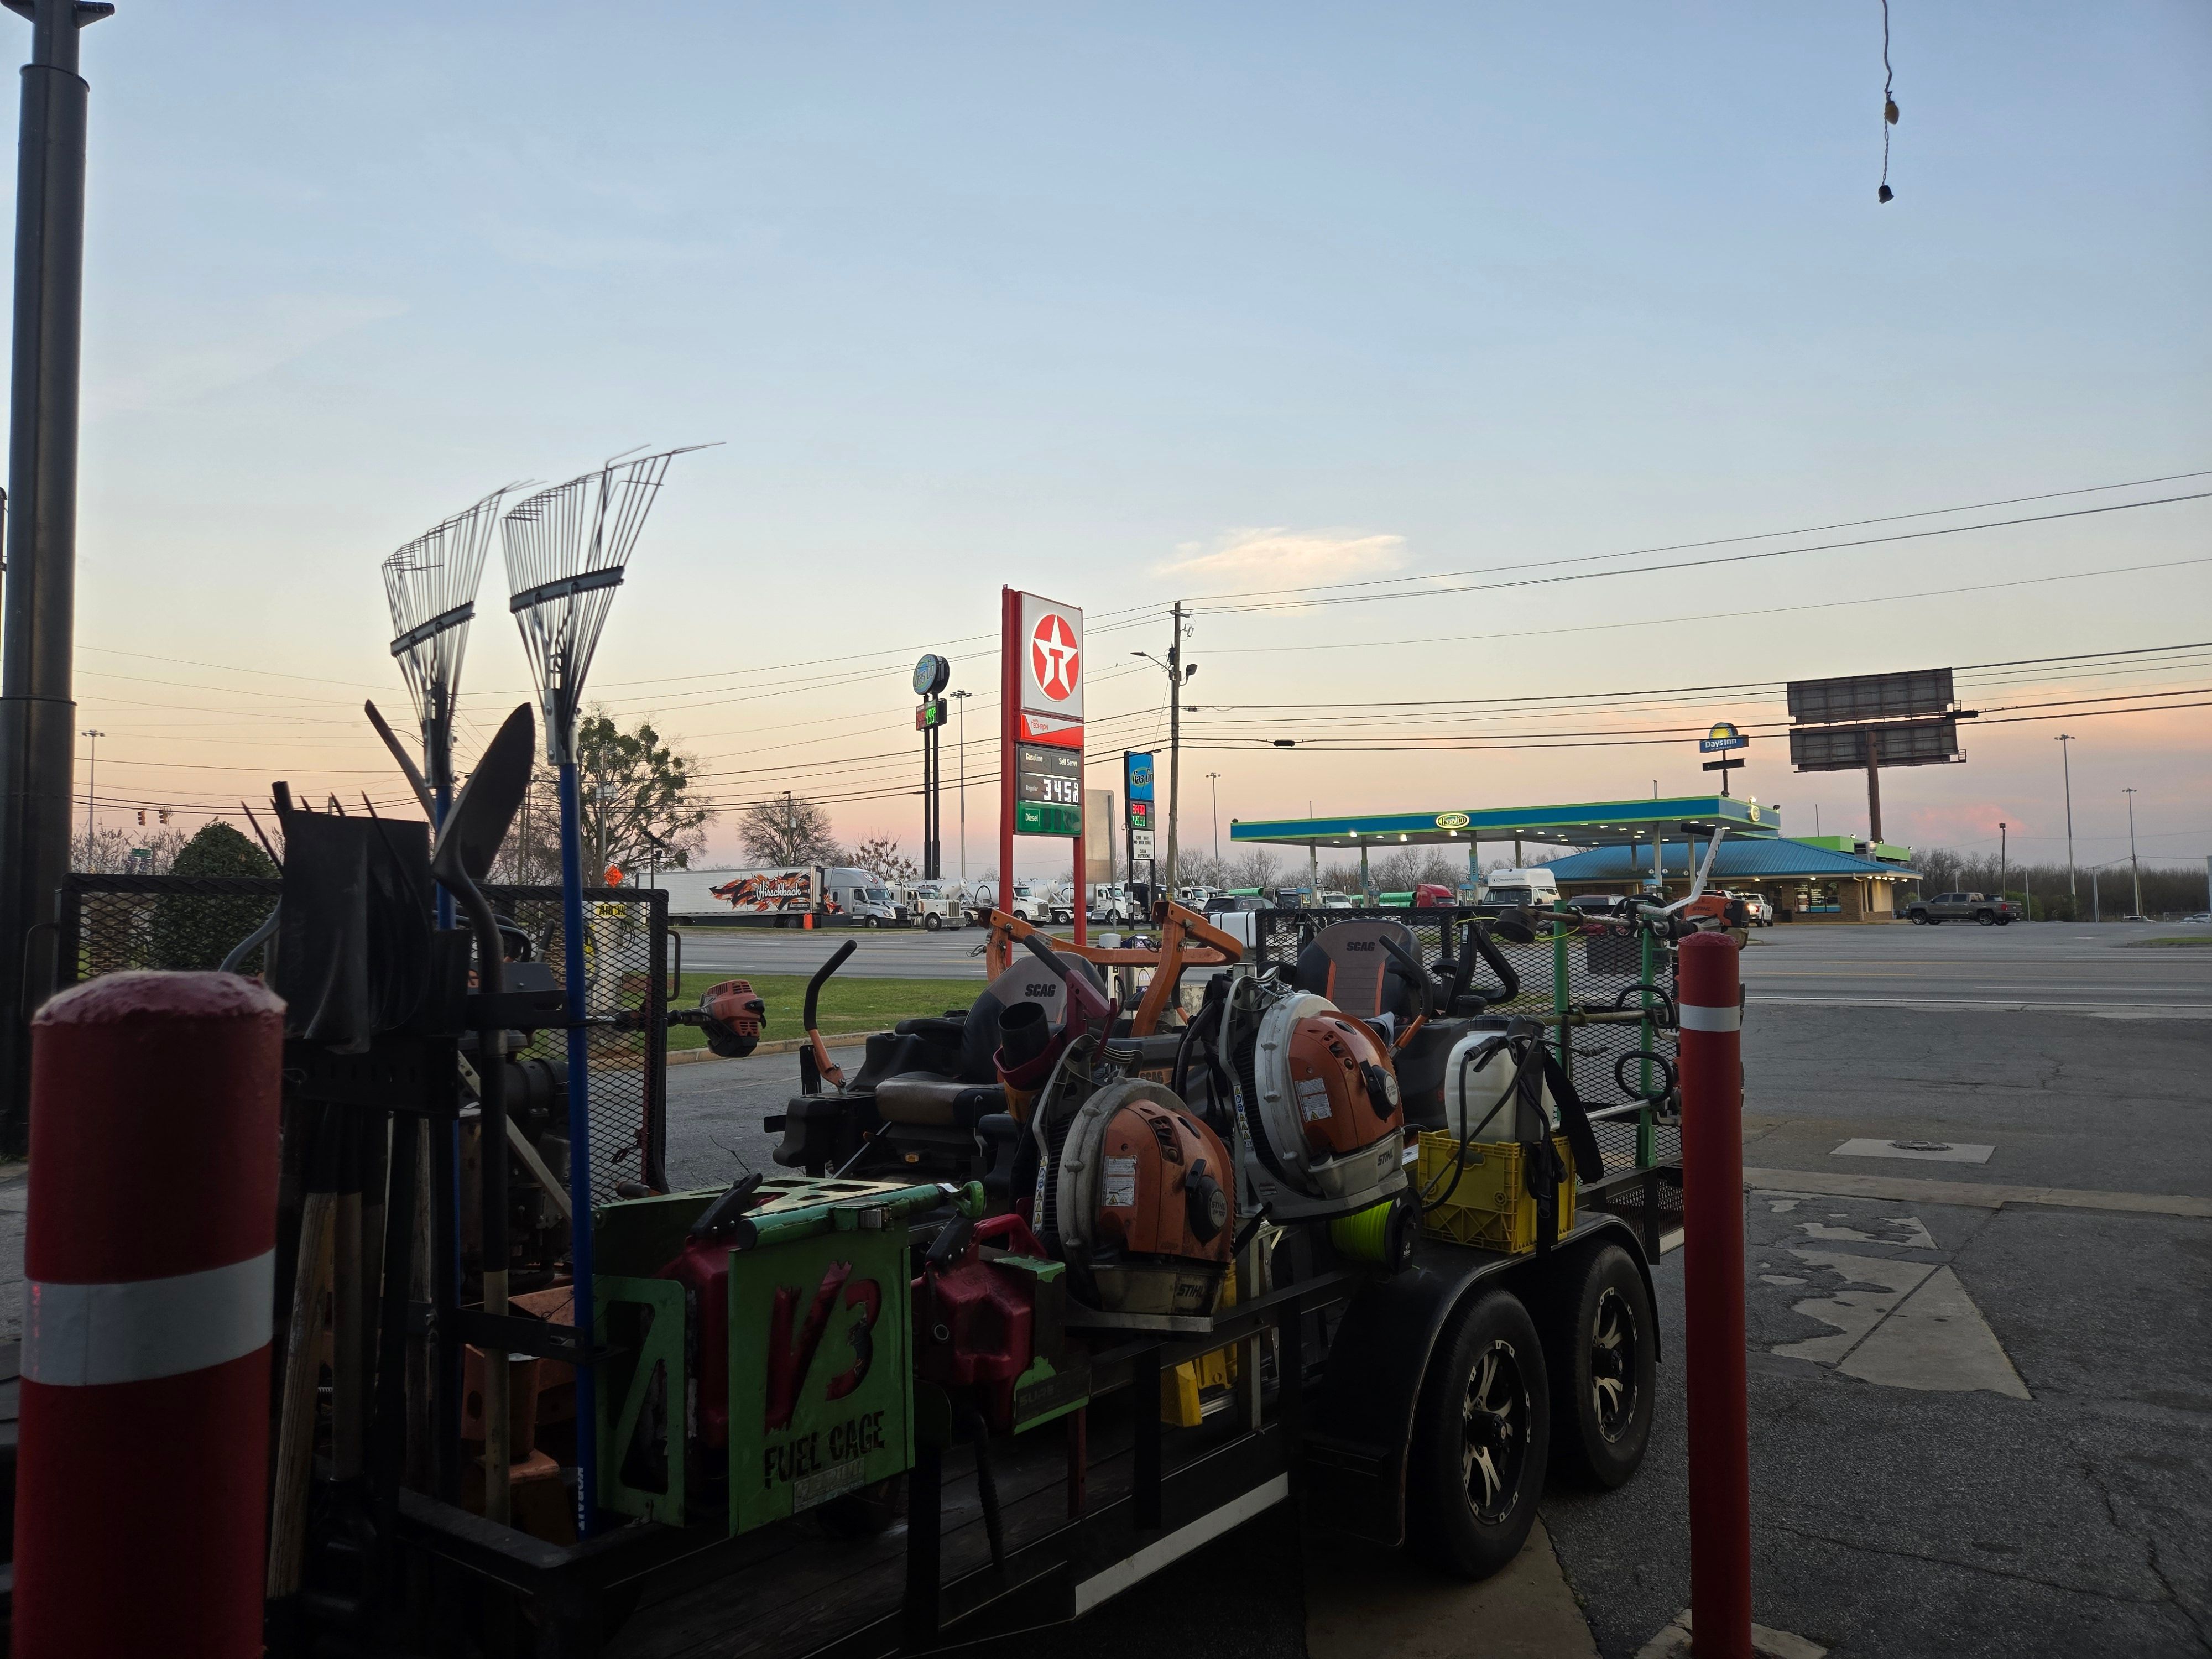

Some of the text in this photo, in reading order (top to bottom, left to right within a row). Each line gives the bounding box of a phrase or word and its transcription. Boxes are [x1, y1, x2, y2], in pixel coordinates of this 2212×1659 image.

[1031, 721, 1048, 731] TECHRON
[1705, 740, 1723, 748] Days
[1025, 753, 1044, 762] Gasoline
[1067, 759, 1078, 767] Serve
[1132, 770, 1144, 785] Gas
[1025, 813, 1039, 822] Diesel
[756, 880, 802, 900] Hirschbach
[1347, 942, 1375, 951] SCAG
[1025, 984, 1056, 997] SCAG
[1378, 1148, 1393, 1166] STIHL
[1211, 1201, 1226, 1211] STIHL
[1176, 1283, 1204, 1298] STIHL
[764, 1260, 882, 1437] V3
[764, 1432, 822, 1490] FUEL
[830, 1410, 885, 1462] CAGE
